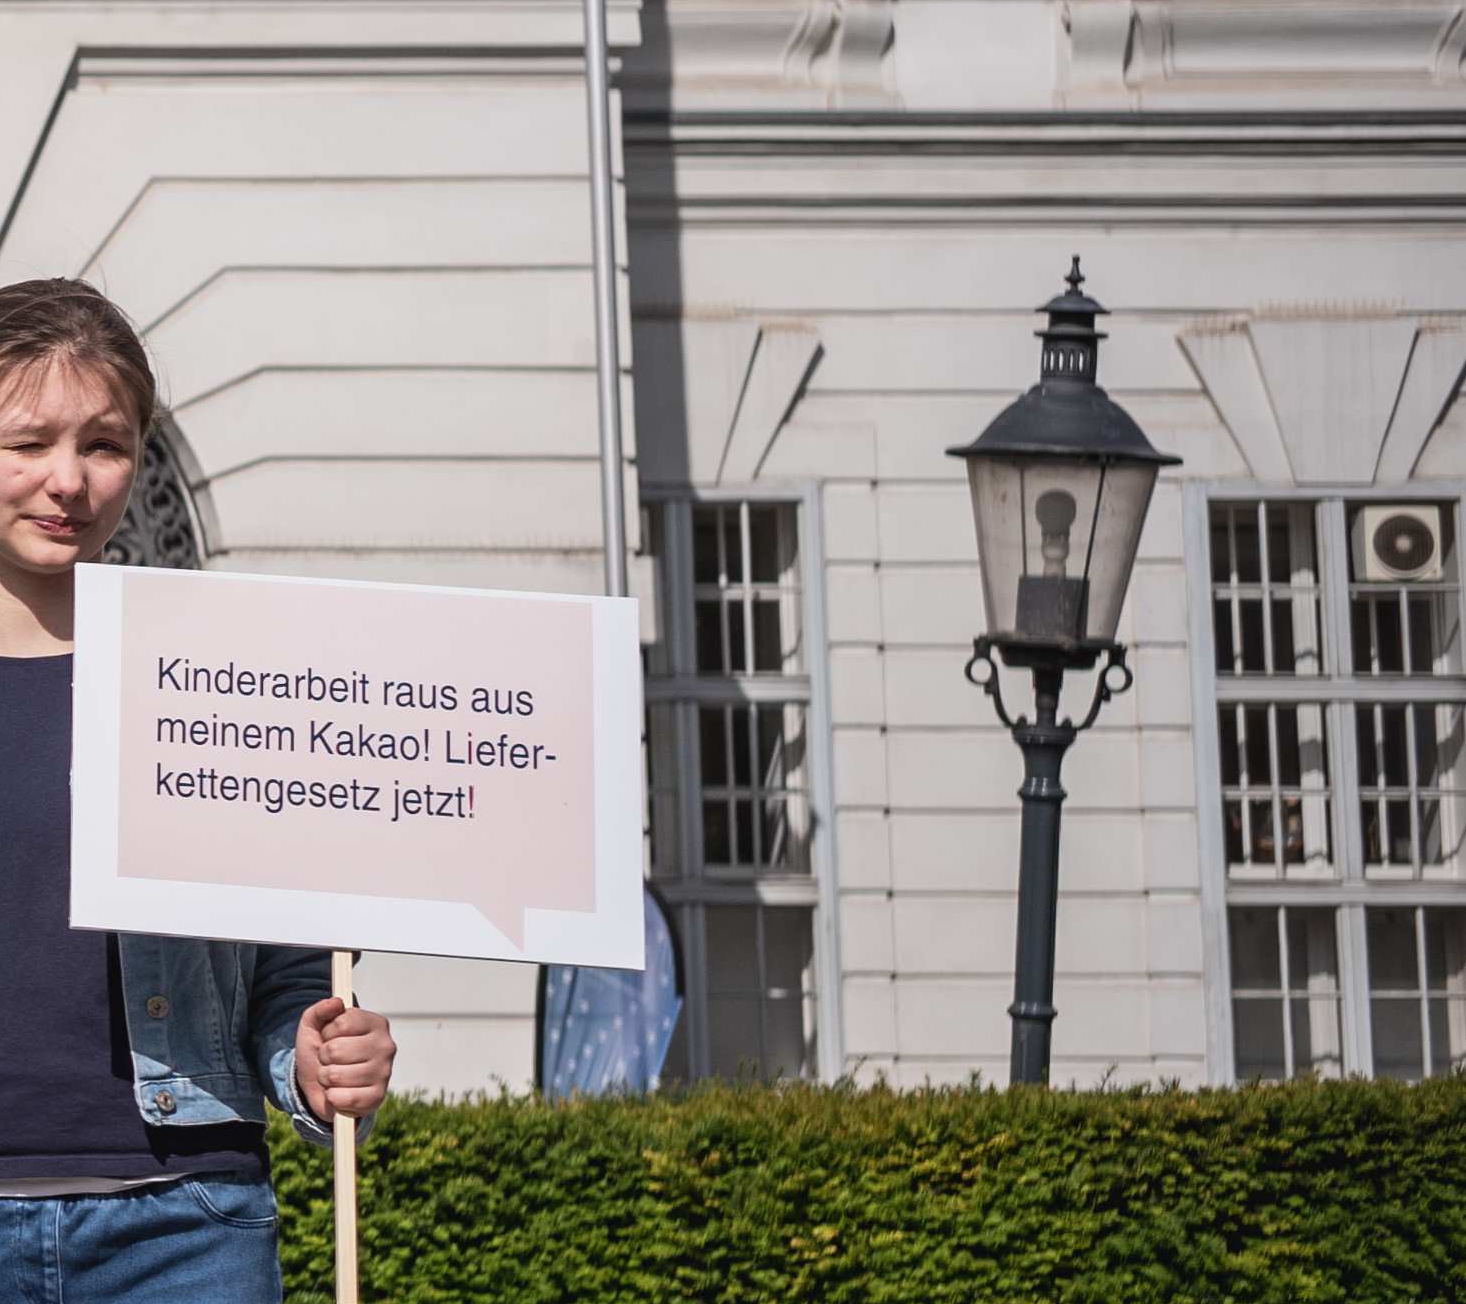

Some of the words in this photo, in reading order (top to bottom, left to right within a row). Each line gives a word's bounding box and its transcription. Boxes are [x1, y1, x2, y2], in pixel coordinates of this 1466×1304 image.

[158, 656, 370, 705] Kinderarbeit
[383, 680, 458, 711] raus
[470, 687, 534, 717] aus
[156, 712, 295, 753] meinem
[309, 719, 430, 762] Kakao!
[445, 729, 557, 770] Liefer-
[156, 761, 381, 814] kettengesetz
[390, 779, 475, 823] jetzt!
